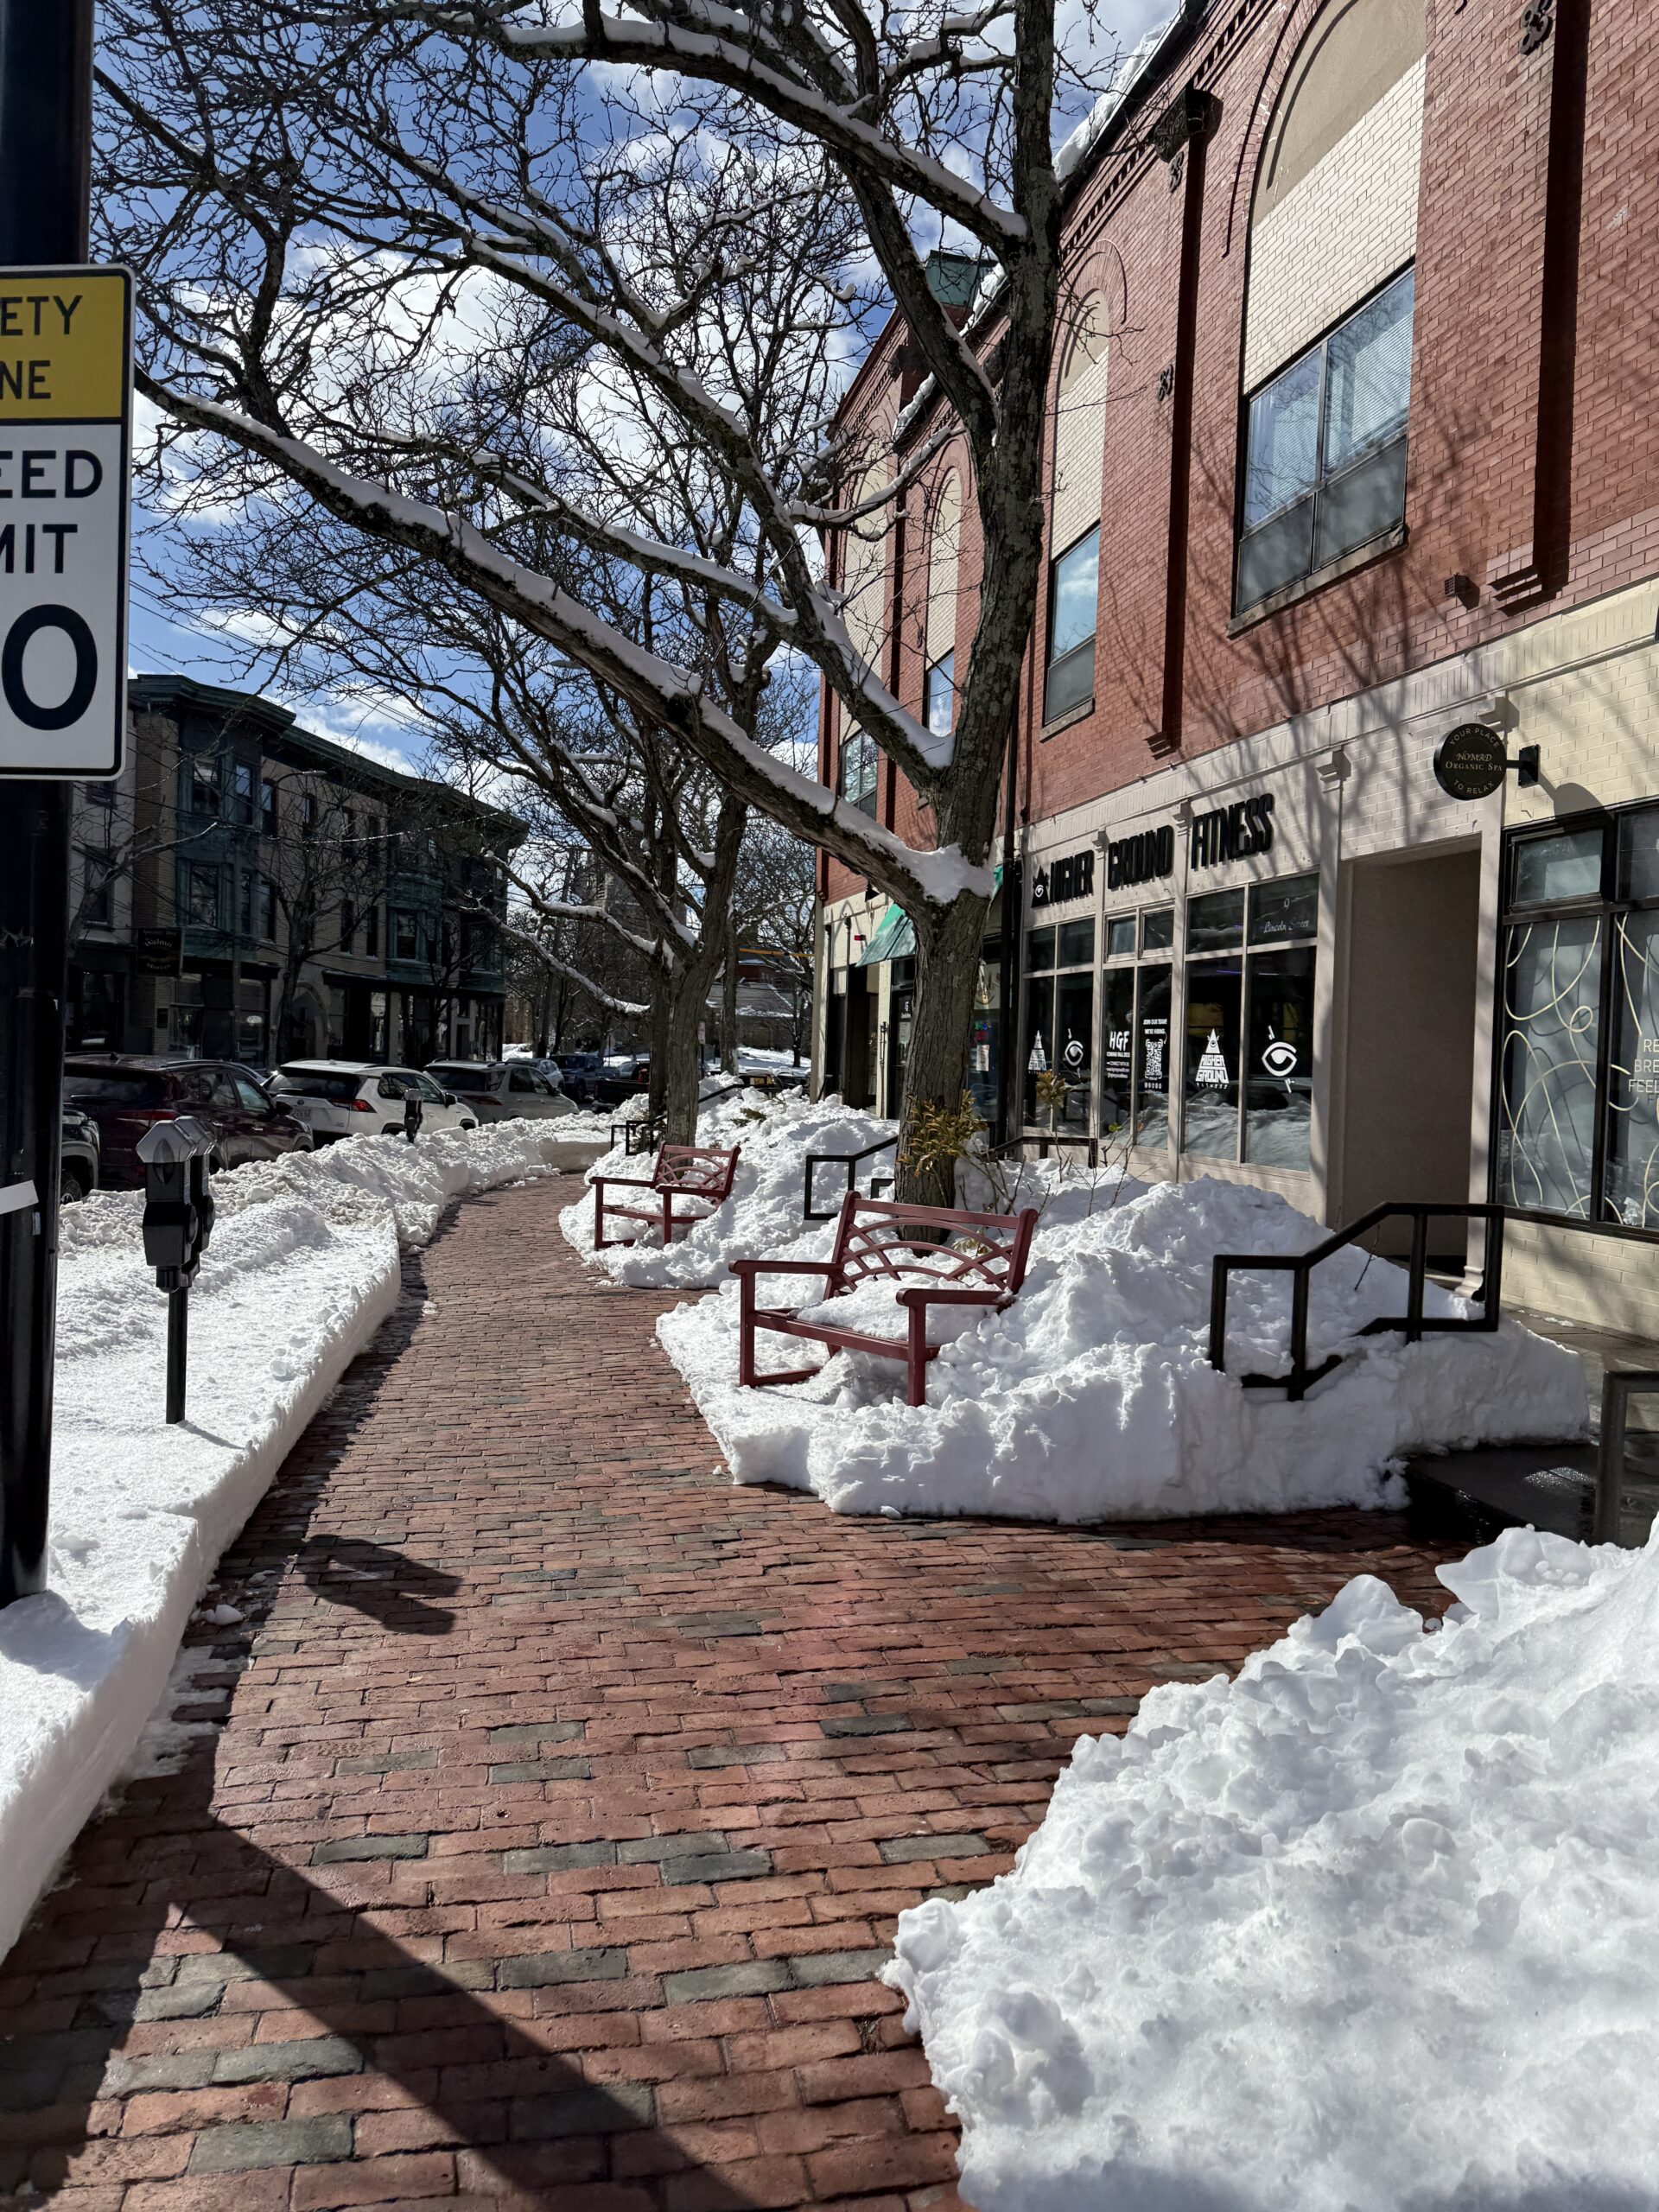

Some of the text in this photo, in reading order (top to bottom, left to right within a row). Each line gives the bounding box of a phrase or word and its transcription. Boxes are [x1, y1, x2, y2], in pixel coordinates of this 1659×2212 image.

[0, 296, 83, 335] ETY
[0, 360, 51, 399] NE
[2, 604, 98, 730] 0
[1450, 728, 1499, 747] YOUR PLACE
[1454, 780, 1494, 794] TO RELAX
[1050, 793, 1274, 904] HIGHER GROUND FITNESS
[1264, 920, 1287, 933] Lincoln
[1109, 1031, 1129, 1051] HGF
[1643, 1039, 1659, 1052] RE
[1199, 1054, 1225, 1067] HIGHER
[1634, 1059, 1659, 1072] BRE
[1195, 1069, 1230, 1084] GROUND
[1628, 1078, 1659, 1094] FEEL
